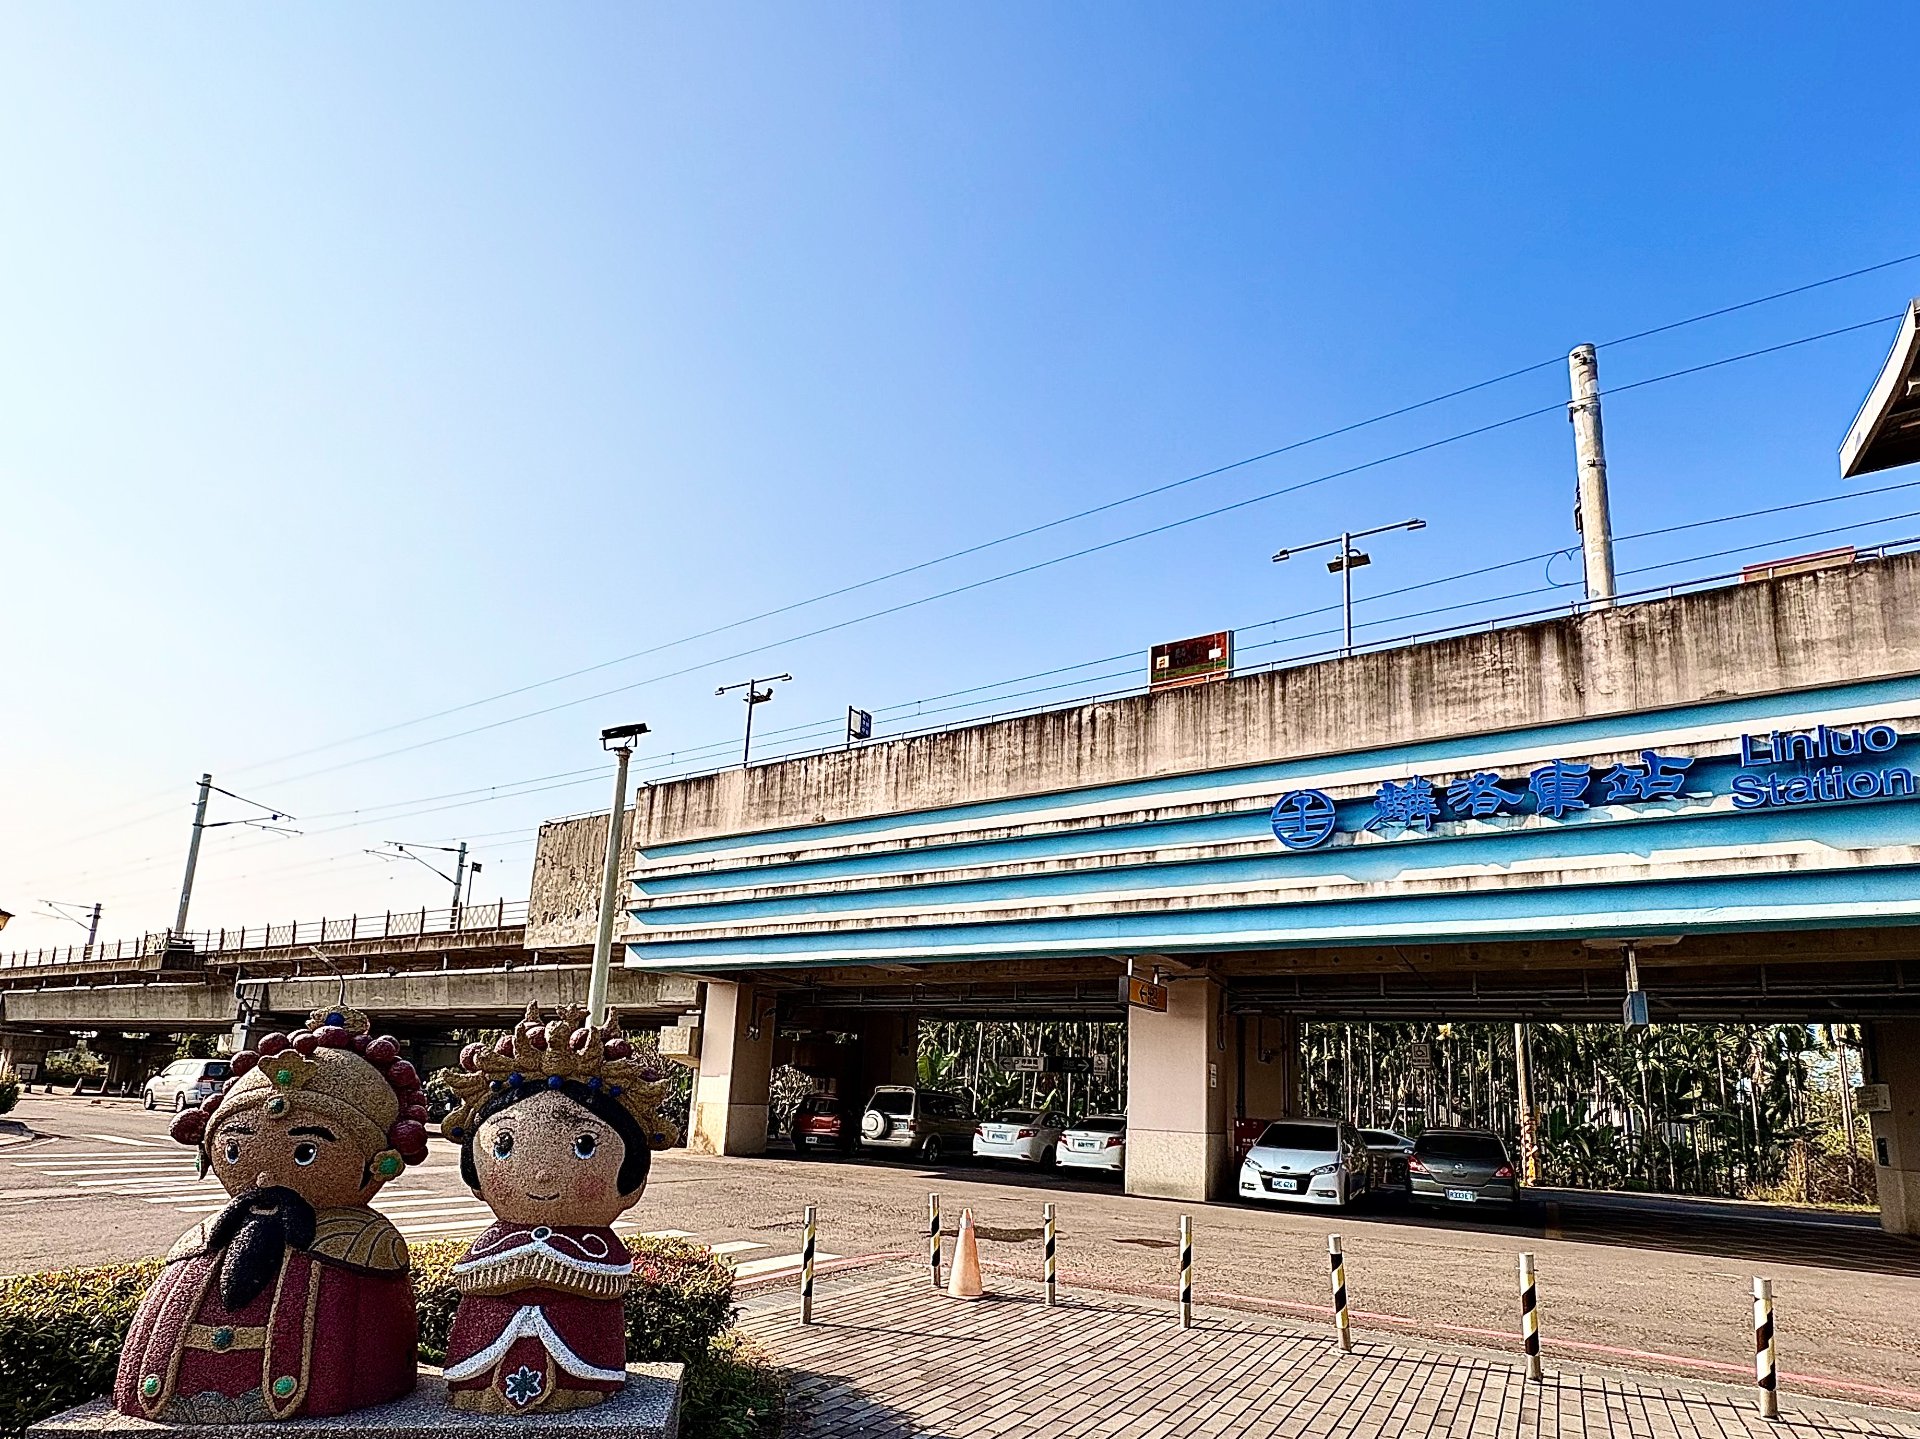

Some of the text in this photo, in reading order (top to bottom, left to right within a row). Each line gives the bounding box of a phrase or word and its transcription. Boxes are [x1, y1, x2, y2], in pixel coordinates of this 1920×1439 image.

[1740, 724, 1898, 768] Linluo
[1363, 750, 1695, 831] 麟洛車站
[1731, 765, 1915, 809] Station
